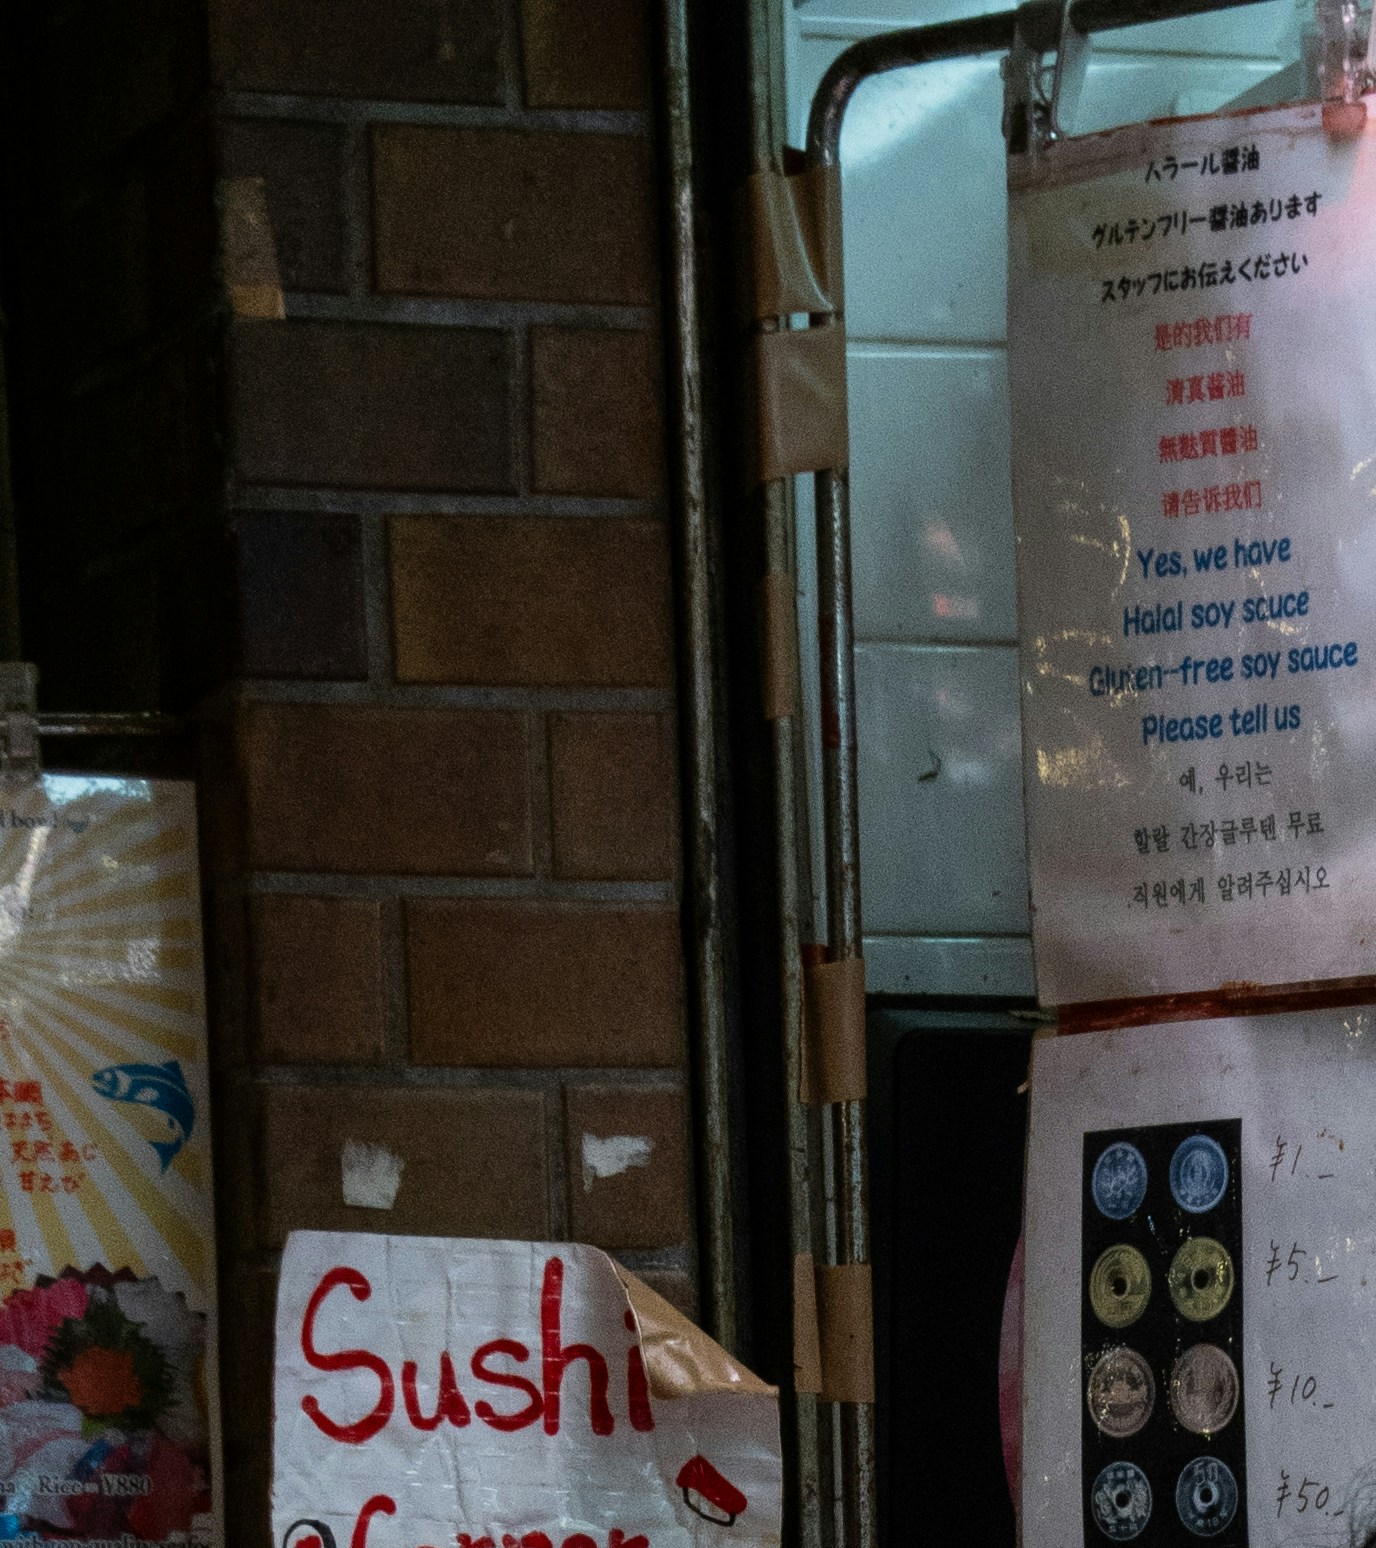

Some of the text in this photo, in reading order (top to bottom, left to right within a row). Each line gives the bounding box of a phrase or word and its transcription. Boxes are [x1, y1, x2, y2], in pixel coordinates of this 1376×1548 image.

[1101, 251, 1309, 303] スタッフにお伝えください
[1137, 536, 1292, 580] Yes, we have
[1123, 601, 1184, 637] Halal
[1191, 600, 1236, 629] soy
[1241, 650, 1281, 681] soy
[1287, 641, 1359, 675] sauce
[1141, 702, 1302, 746] Please tell us
[1214, 759, 1273, 792] 우리는
[299, 1256, 656, 1443] Sushi
